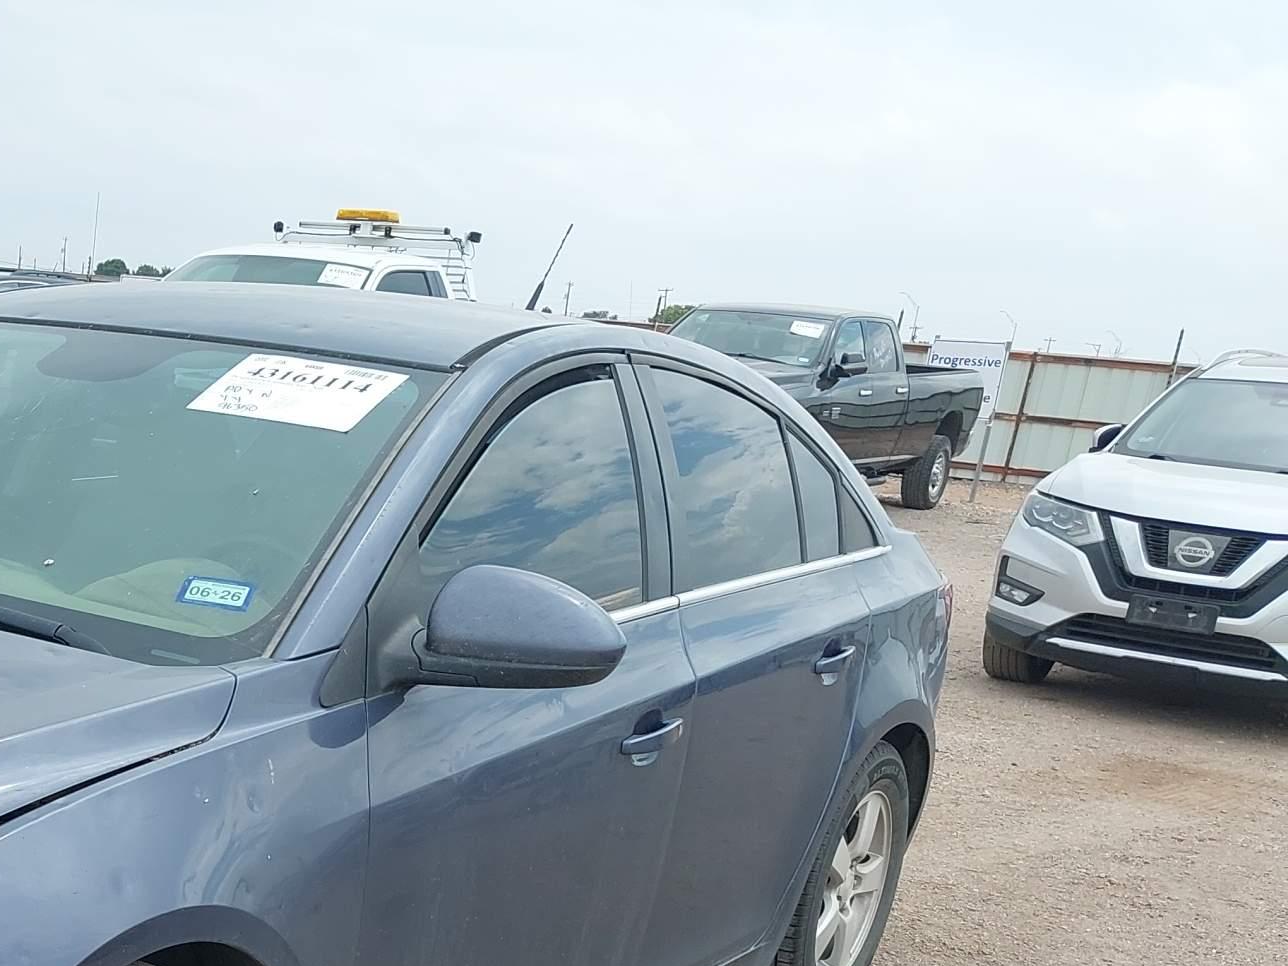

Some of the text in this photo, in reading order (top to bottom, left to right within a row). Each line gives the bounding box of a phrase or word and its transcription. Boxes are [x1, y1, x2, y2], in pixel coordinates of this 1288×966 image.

[930, 353, 1002, 369] Progressive
[247, 366, 374, 393] 43161114
[1177, 547, 1210, 556] NISSAN
[188, 585, 212, 598] 06
[218, 589, 243, 602] 26
